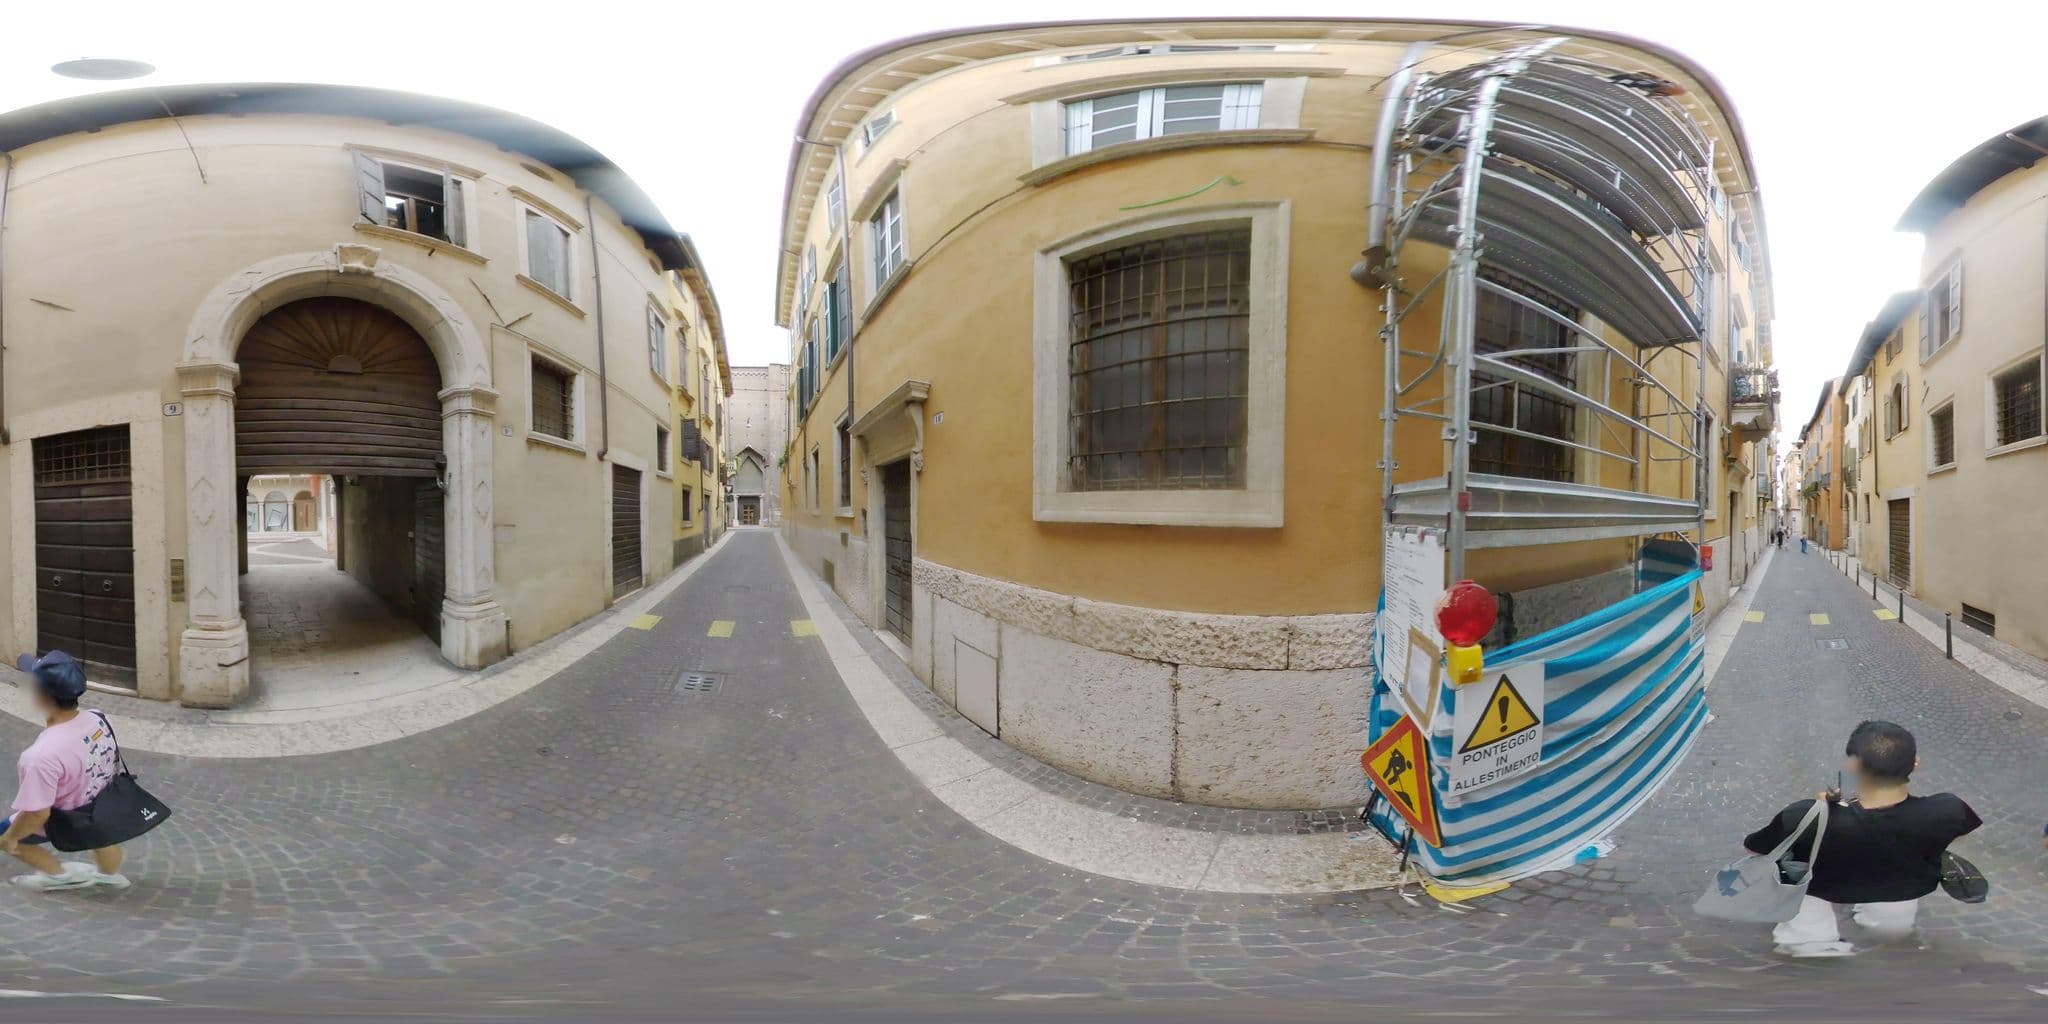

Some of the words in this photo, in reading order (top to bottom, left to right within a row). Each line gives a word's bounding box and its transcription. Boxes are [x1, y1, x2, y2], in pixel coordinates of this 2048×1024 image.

[1462, 729, 1537, 766] PONTEGGIO
[1496, 754, 1508, 767] IN
[1454, 752, 1539, 791] ALLESTIMENTO
